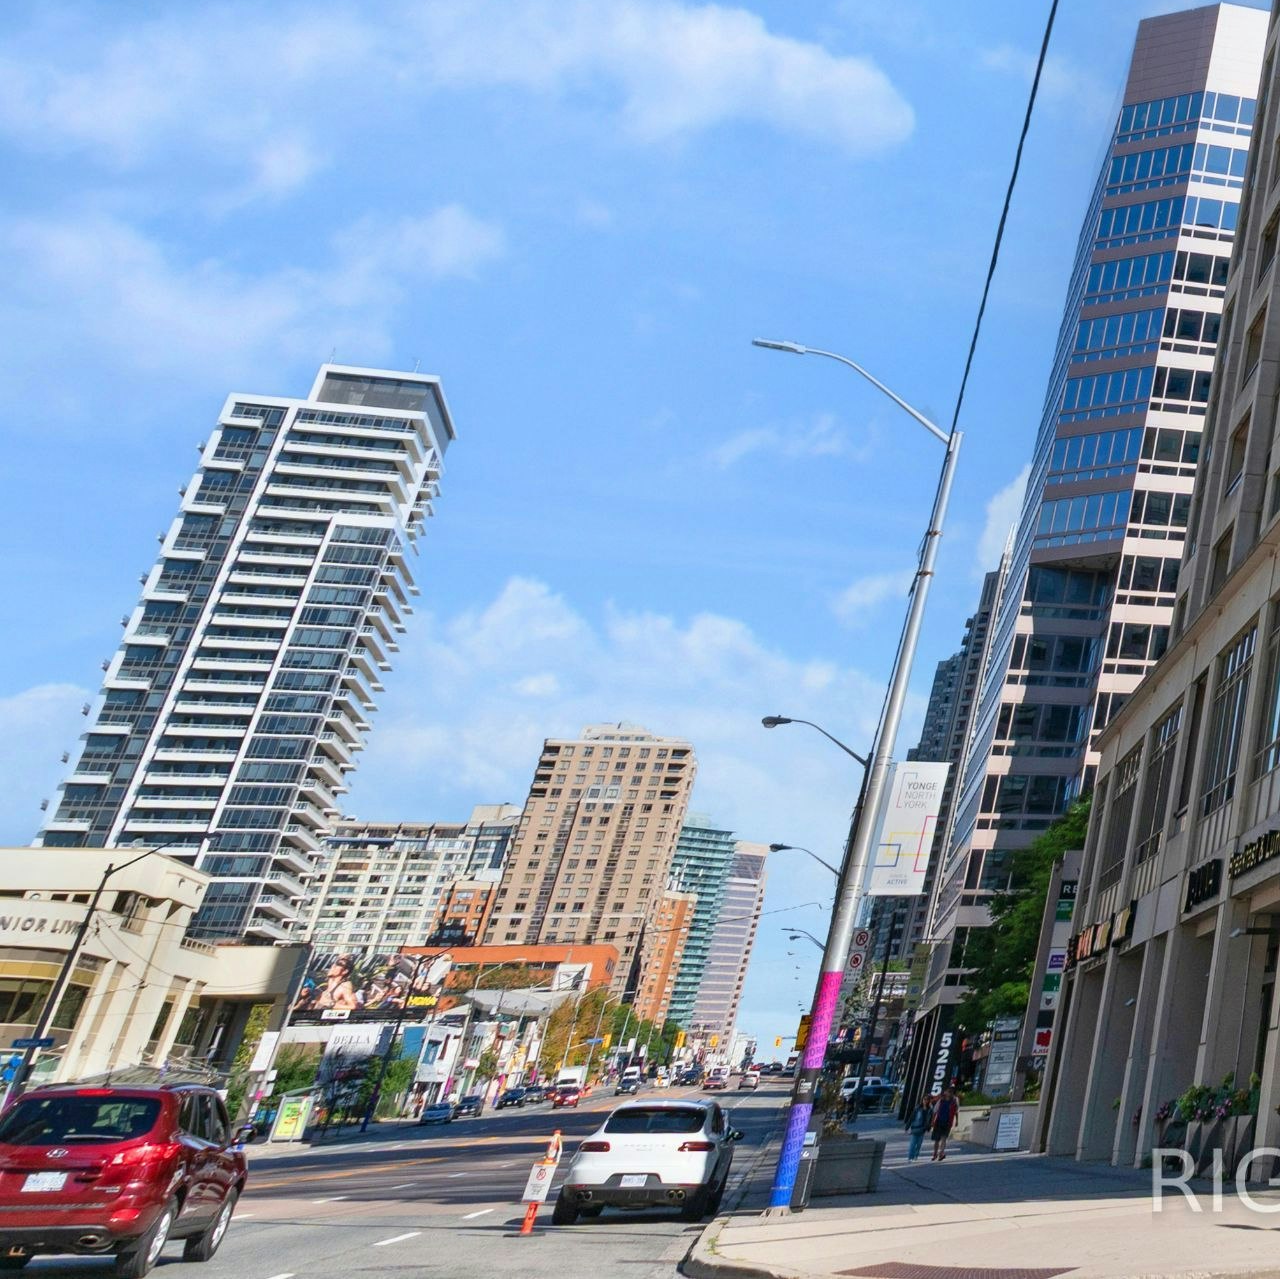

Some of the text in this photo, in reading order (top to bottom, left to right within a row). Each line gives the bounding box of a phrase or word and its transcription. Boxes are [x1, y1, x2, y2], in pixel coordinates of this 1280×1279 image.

[907, 782, 938, 791] YONGE
[904, 791, 936, 800] NORTH
[903, 801, 928, 809] YORK
[930, 1032, 953, 1097] 5255
